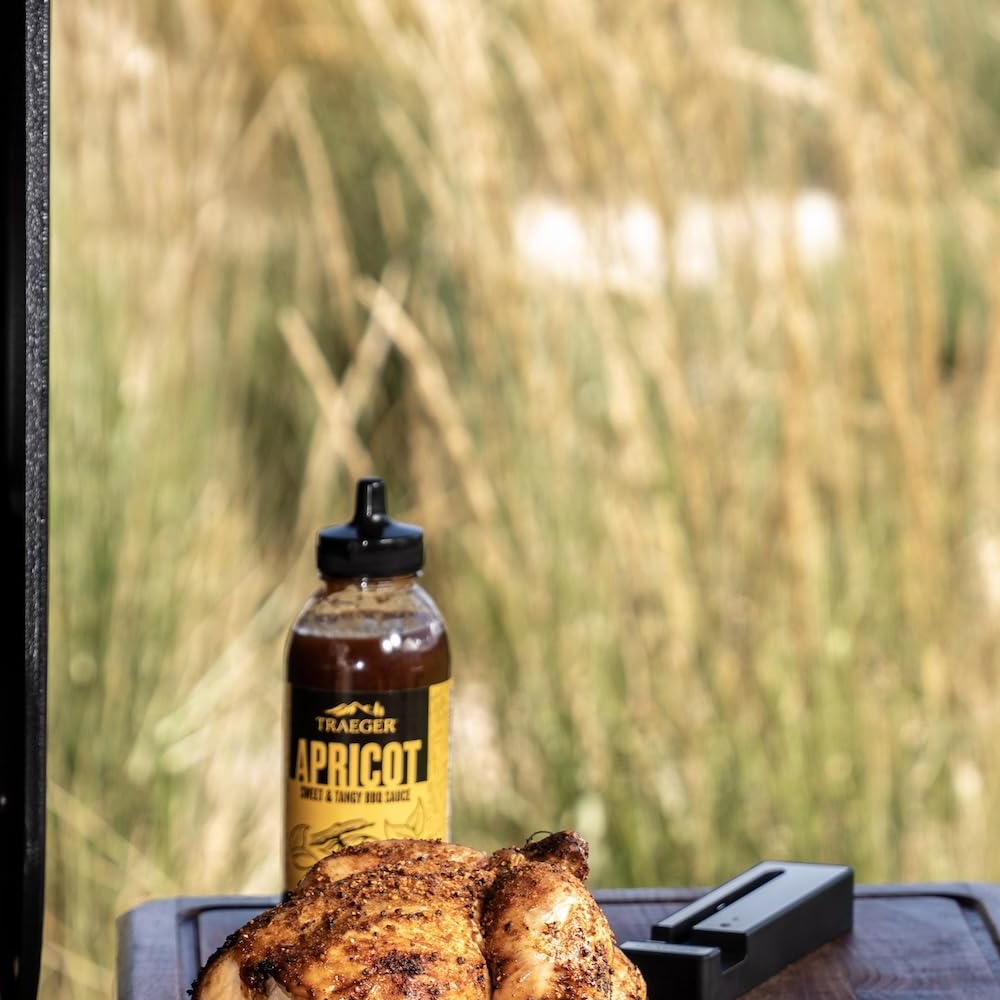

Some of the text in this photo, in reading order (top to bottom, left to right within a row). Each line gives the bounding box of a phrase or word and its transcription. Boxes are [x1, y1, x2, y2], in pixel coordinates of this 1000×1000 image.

[315, 716, 397, 734] TRAEGER
[295, 738, 422, 787] APRICOT
[300, 785, 323, 801] SWEET
[326, 788, 332, 802] &
[335, 788, 361, 803] TANGY
